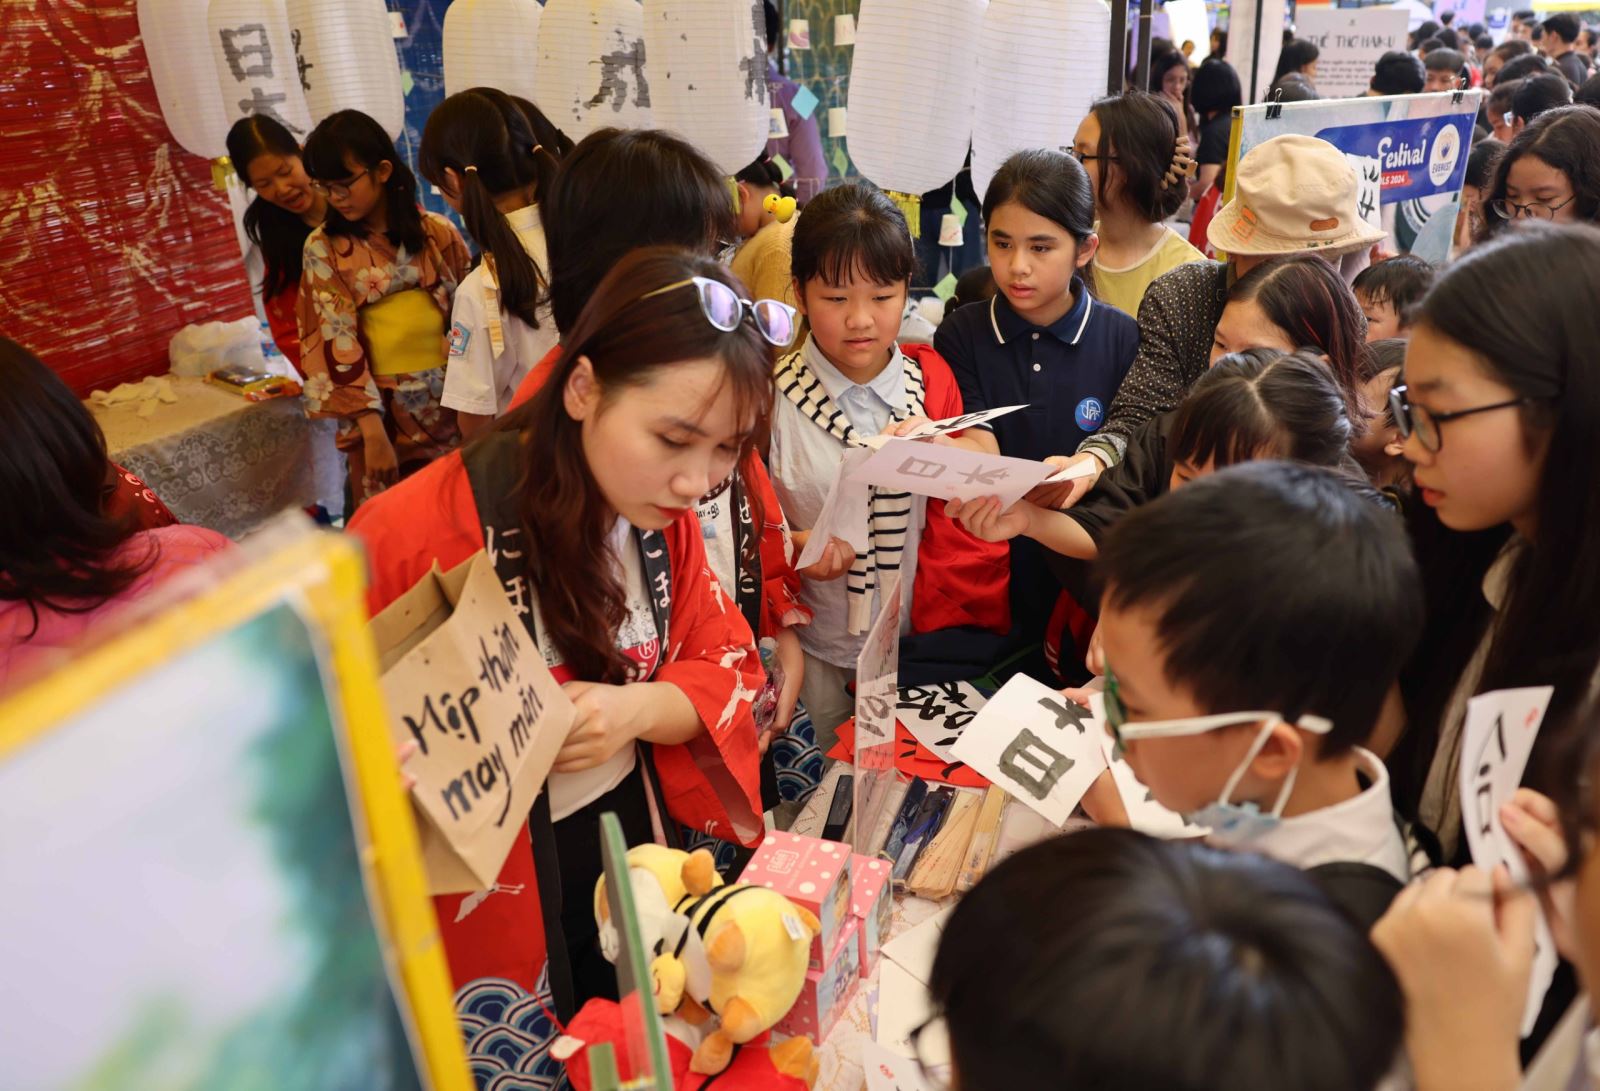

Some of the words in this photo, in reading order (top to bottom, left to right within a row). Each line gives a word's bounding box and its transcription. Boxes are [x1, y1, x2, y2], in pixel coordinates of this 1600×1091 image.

[219, 24, 306, 135] 日本
[1378, 136, 1427, 169] Festival
[441, 743, 512, 828] may
